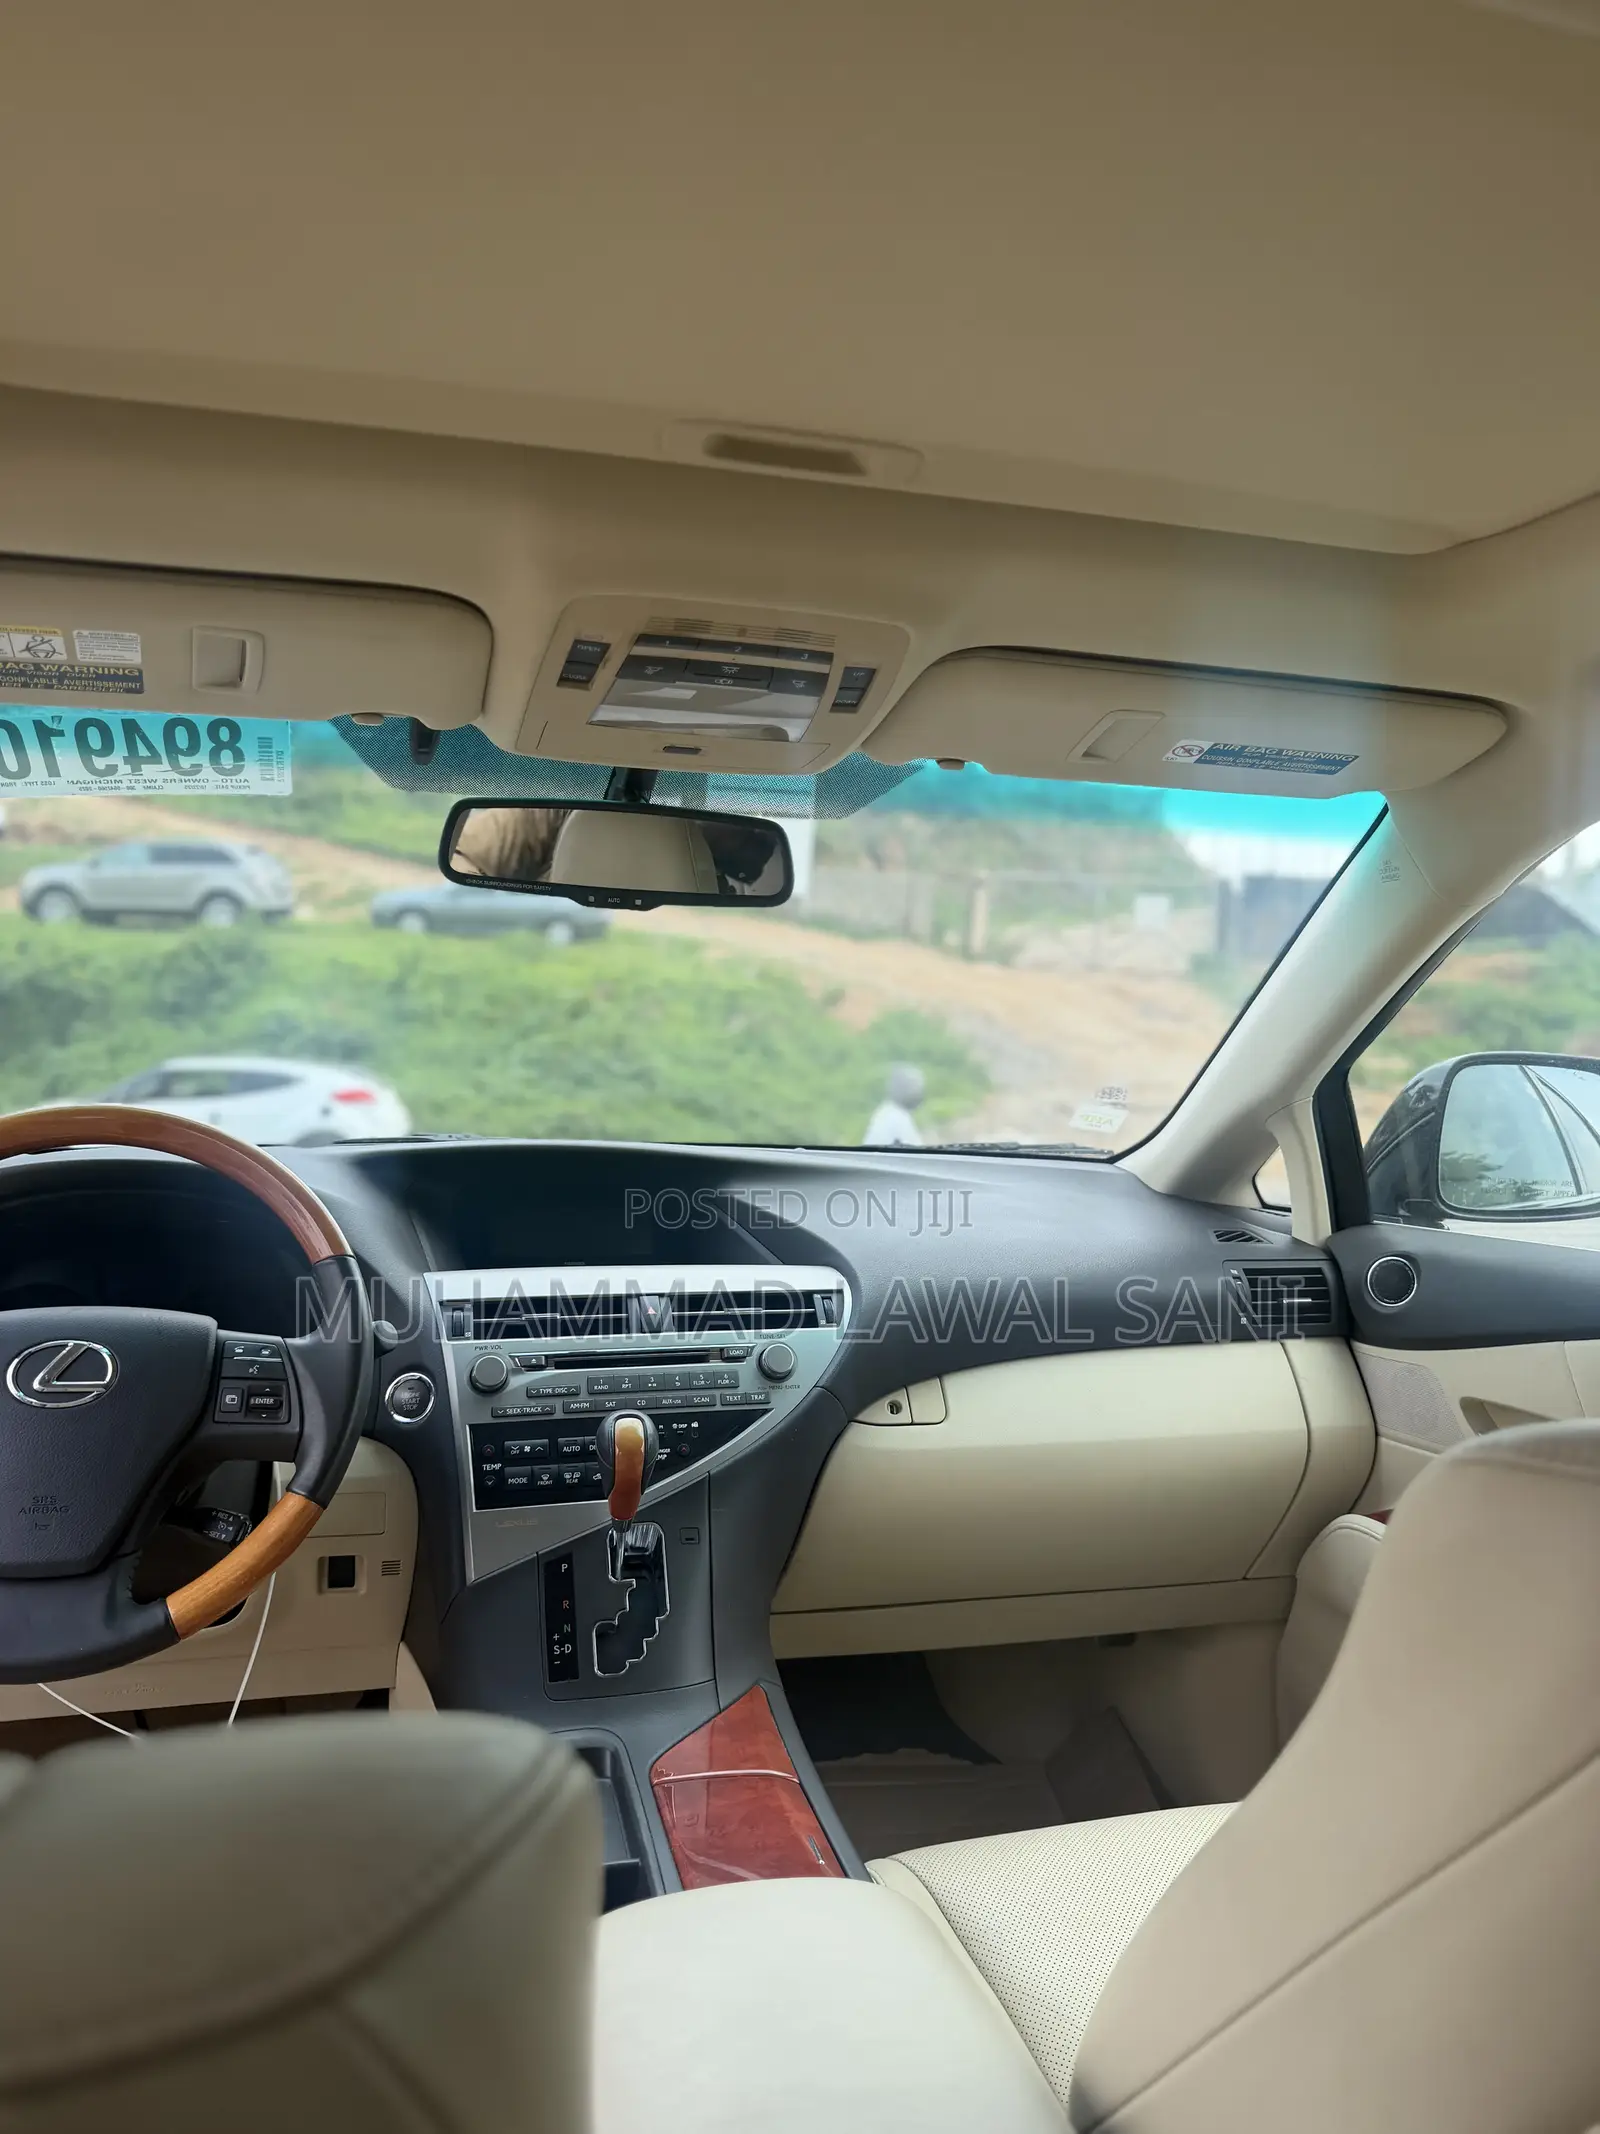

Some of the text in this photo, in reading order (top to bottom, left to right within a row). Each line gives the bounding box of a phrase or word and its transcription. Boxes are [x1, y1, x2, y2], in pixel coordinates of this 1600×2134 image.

[577, 644, 601, 652] OPEN
[40, 663, 139, 677] WARNING
[63, 679, 141, 690] AVERTISSEMENT
[1212, 743, 1356, 762] AIR BAG WARNING
[1282, 761, 1342, 772] AVERTISSEMENT
[483, 880, 523, 889] SURROUNDINGS
[533, 884, 552, 892] SAFETY
[607, 896, 621, 904] AUTO
[1560, 1180, 1575, 1188] ARE
[729, 1348, 745, 1356] LOAD
[254, 1397, 275, 1405] ENTER
[401, 1397, 421, 1405] START
[693, 1395, 710, 1404] SCAN
[726, 1394, 742, 1402] TEXT
[750, 1393, 766, 1401] TRAF
[605, 1400, 617, 1408] SAT
[636, 1398, 646, 1406] CD
[402, 1403, 418, 1411] STOP
[562, 1445, 581, 1453] AUTO
[481, 1463, 502, 1471] TEMP
[507, 1476, 529, 1485] MODE
[32, 1495, 58, 1505] SRS
[17, 1505, 71, 1516] AIRBAG
[216, 1511, 229, 1520] RES
[208, 1530, 221, 1540] SET
[561, 1563, 569, 1573] P
[562, 1600, 570, 1609] R
[563, 1623, 571, 1633] N
